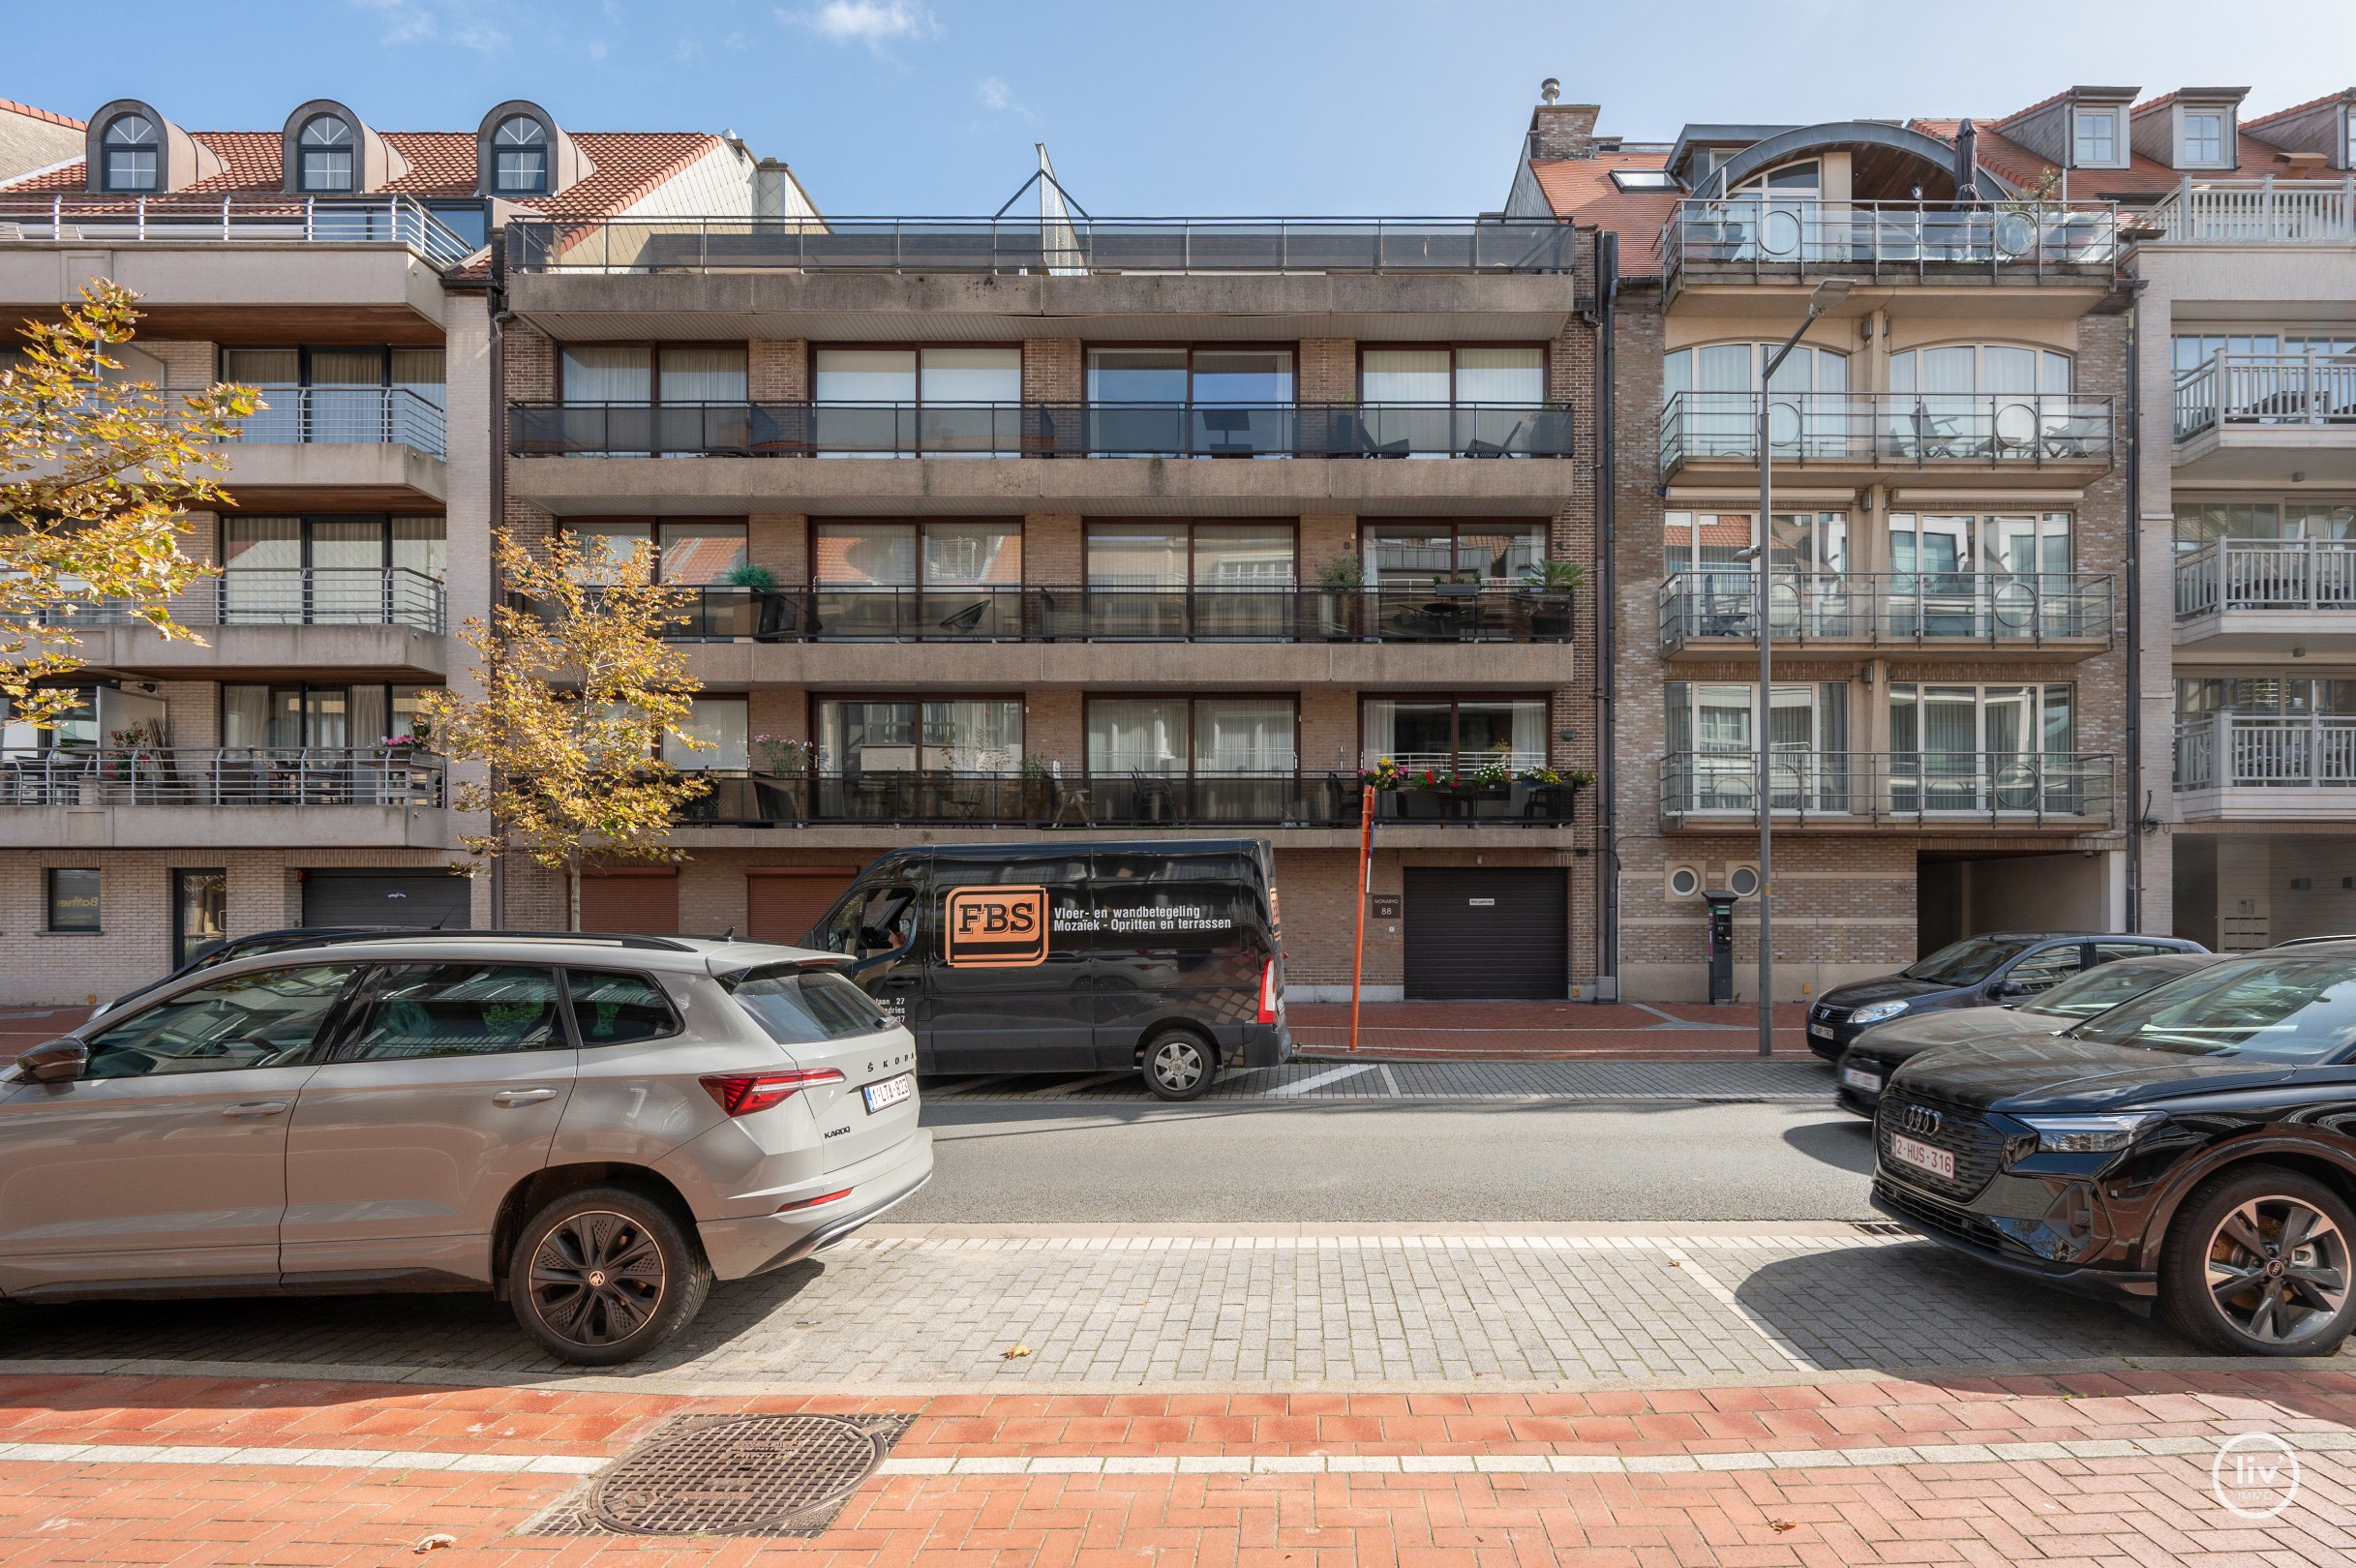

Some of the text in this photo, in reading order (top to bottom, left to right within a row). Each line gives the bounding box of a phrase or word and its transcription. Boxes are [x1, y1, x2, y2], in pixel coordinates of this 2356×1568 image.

[958, 902, 1035, 934] FBS
[1054, 906, 1200, 920] Vloer- en wandbetegeling
[1054, 920, 1100, 932] Mozaïek
[1111, 919, 1156, 932] Opritten
[1161, 920, 1174, 929] en
[1178, 919, 1231, 929] terrassen
[824, 1126, 851, 1139] KAROQ
